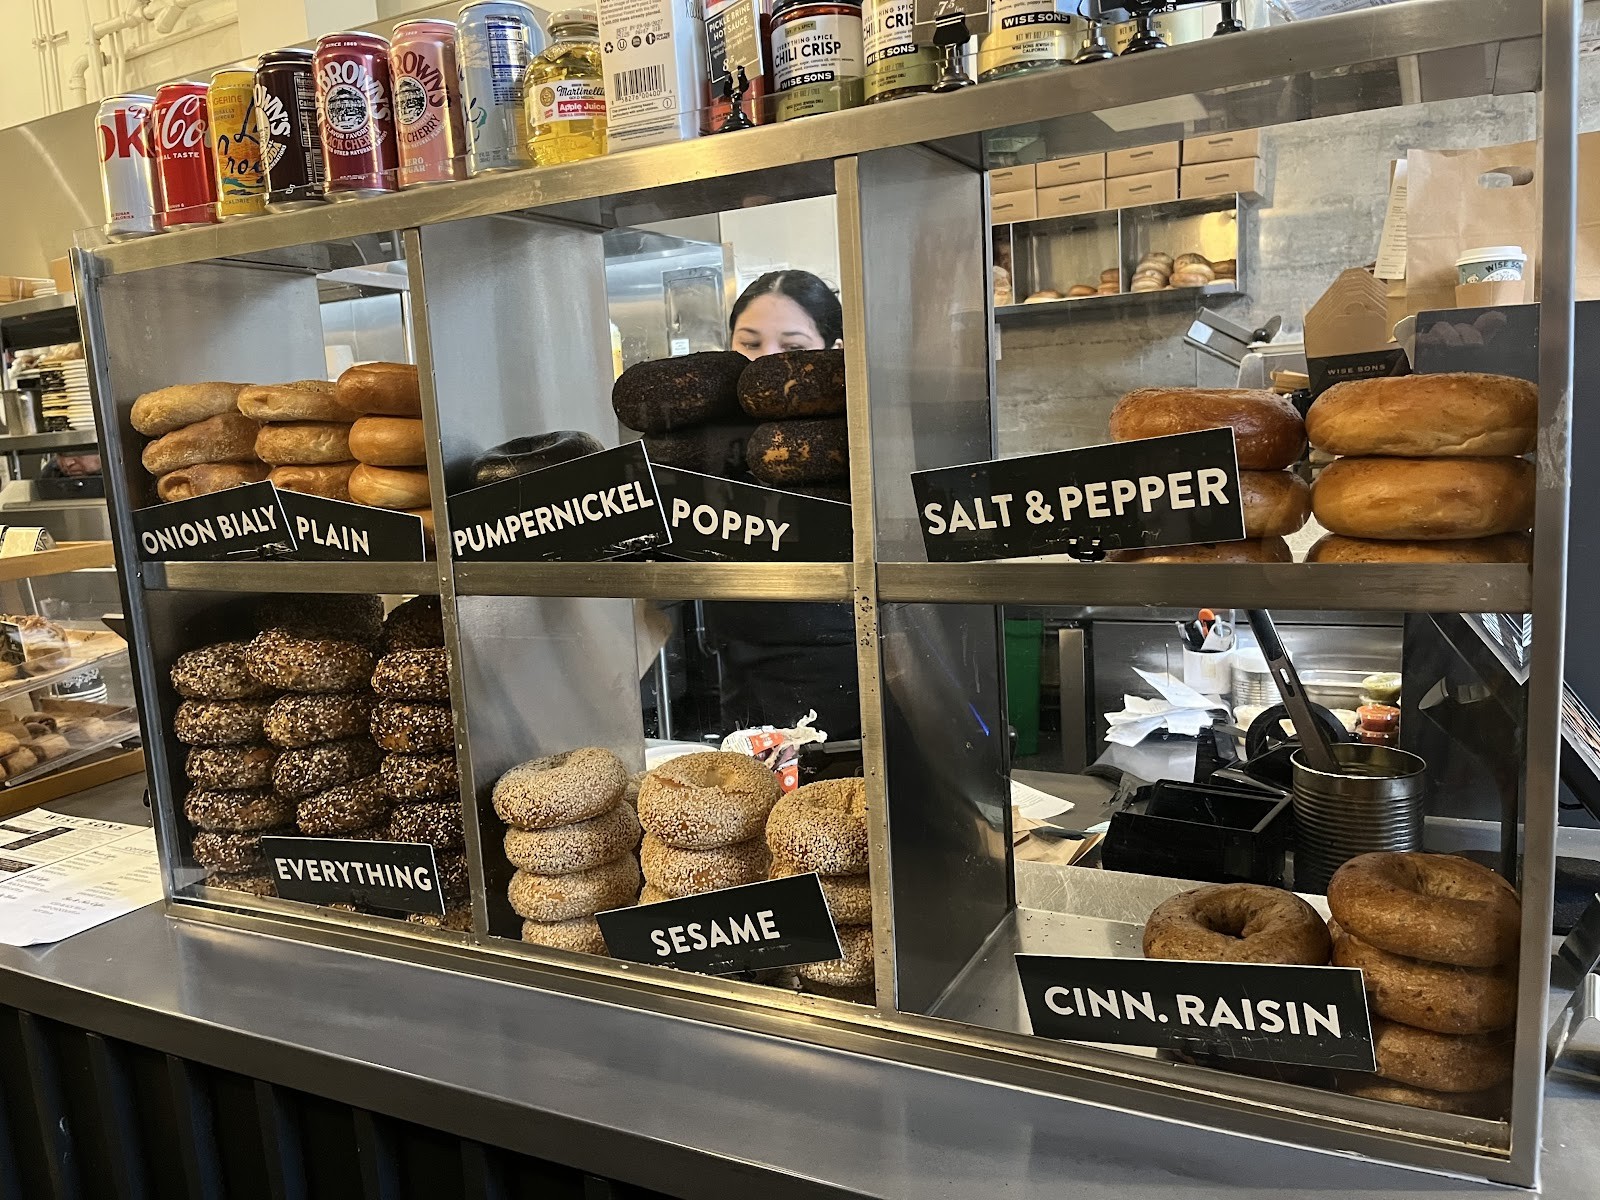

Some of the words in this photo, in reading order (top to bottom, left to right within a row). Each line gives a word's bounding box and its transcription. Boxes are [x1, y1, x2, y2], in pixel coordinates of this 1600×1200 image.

[709, 14, 731, 33] PICKLE
[731, 3, 751, 20] BRINE
[897, 4, 914, 12] SPIC
[1004, 14, 1035, 28] WISE
[1037, 13, 1068, 22] SONS
[713, 28, 727, 42] HOT
[727, 15, 748, 33] SAUCE
[813, 33, 833, 42] SPICE
[774, 47, 798, 68] CHILI
[801, 41, 842, 58] CRISP
[866, 50, 886, 66] WISE
[886, 44, 916, 57] SONS
[317, 60, 392, 123] BROWN'S
[556, 85, 606, 98] Martinelli
[781, 77, 802, 90] WISE
[803, 72, 833, 83] SONS
[559, 103, 583, 113] Apple
[583, 102, 606, 111] Juice
[172, 151, 200, 159] TASTE
[1485, 260, 1508, 273] WISE
[1327, 367, 1354, 376] WISE
[1357, 364, 1386, 372] SONS
[924, 493, 1013, 536] SALT
[1025, 490, 1054, 525] &
[1059, 467, 1230, 521] PEPPER
[141, 518, 217, 555] ONION
[216, 504, 278, 540] BIALY
[453, 481, 654, 557] PUMPERNICKEL
[671, 497, 791, 552] POPPY
[296, 515, 370, 556] PLAIN
[44, 814, 80, 826] WISE
[85, 820, 128, 831] SONS
[274, 857, 433, 892] EVERYTHING
[650, 910, 781, 957] SESAME
[1044, 986, 1168, 1024] CINN.
[1176, 993, 1342, 1039] RAISIN
